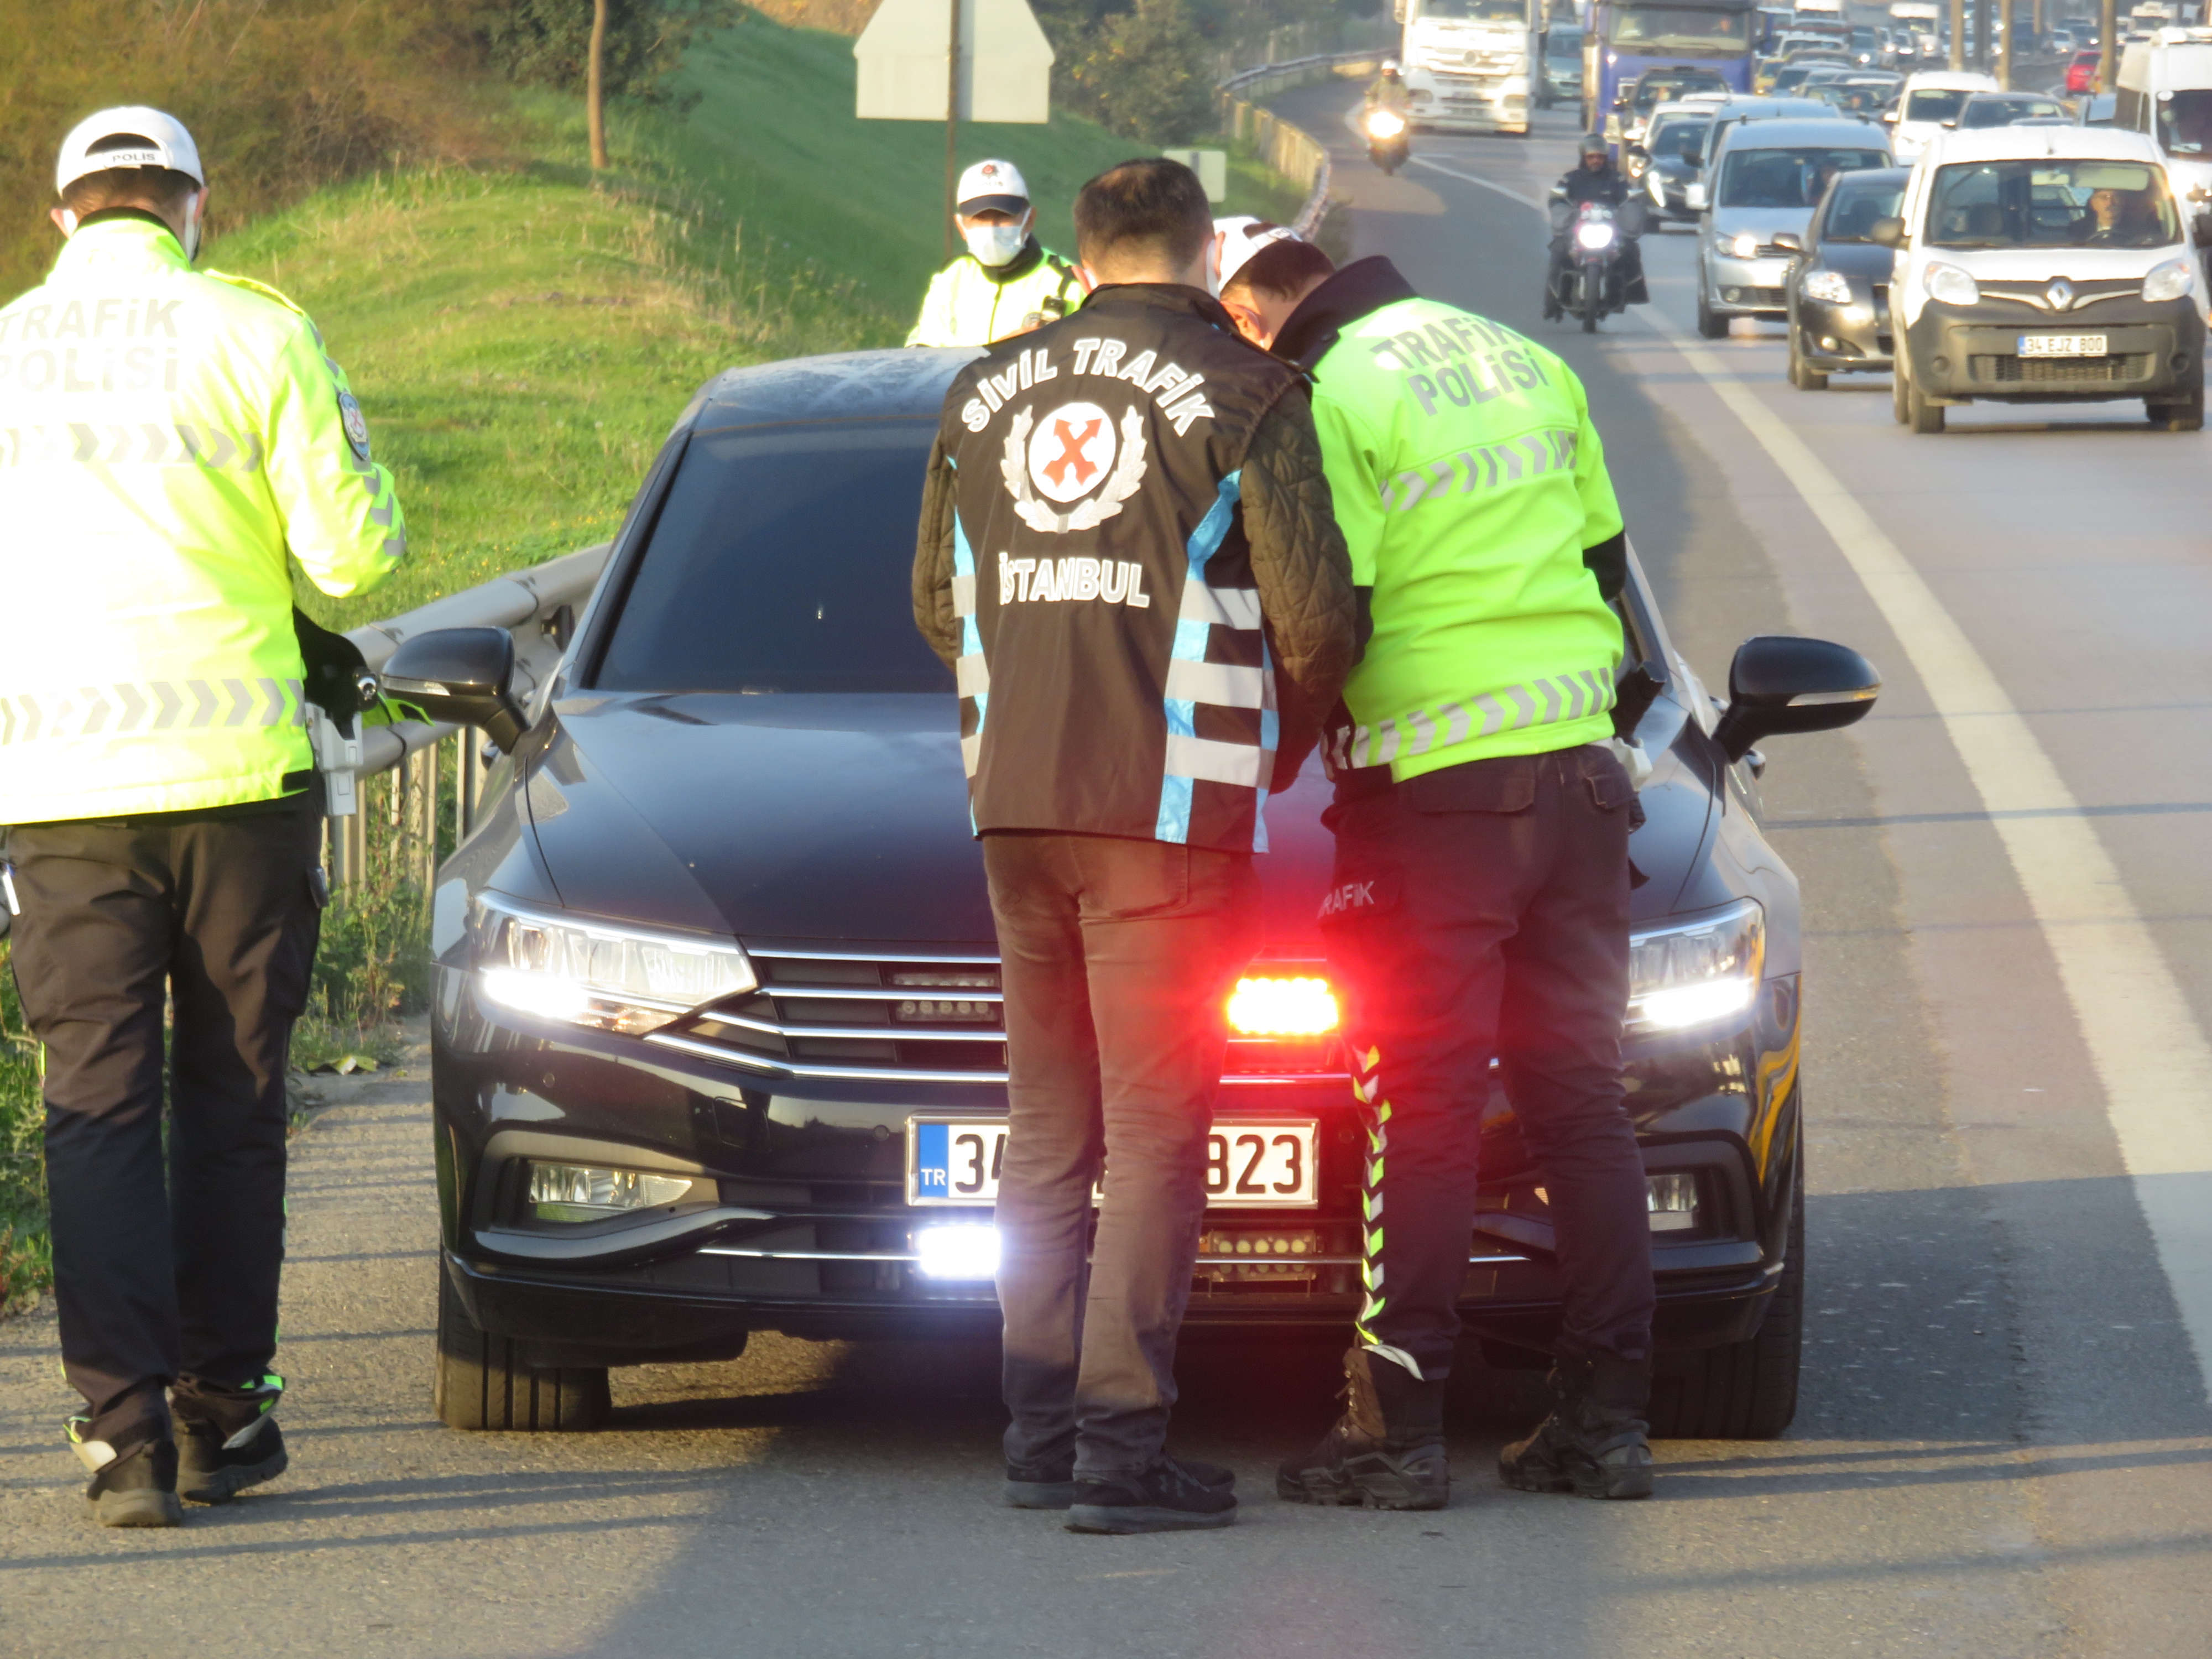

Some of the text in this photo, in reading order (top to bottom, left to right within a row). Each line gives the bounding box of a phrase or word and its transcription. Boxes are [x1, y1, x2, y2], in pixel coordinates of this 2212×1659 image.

[2026, 338, 2042, 352] 34
[1073, 337, 1216, 438] TRAFİK
[998, 551, 1150, 609] İSTANBUL
[1316, 880, 1375, 921] RAFİK
[920, 1168, 946, 1186] TR
